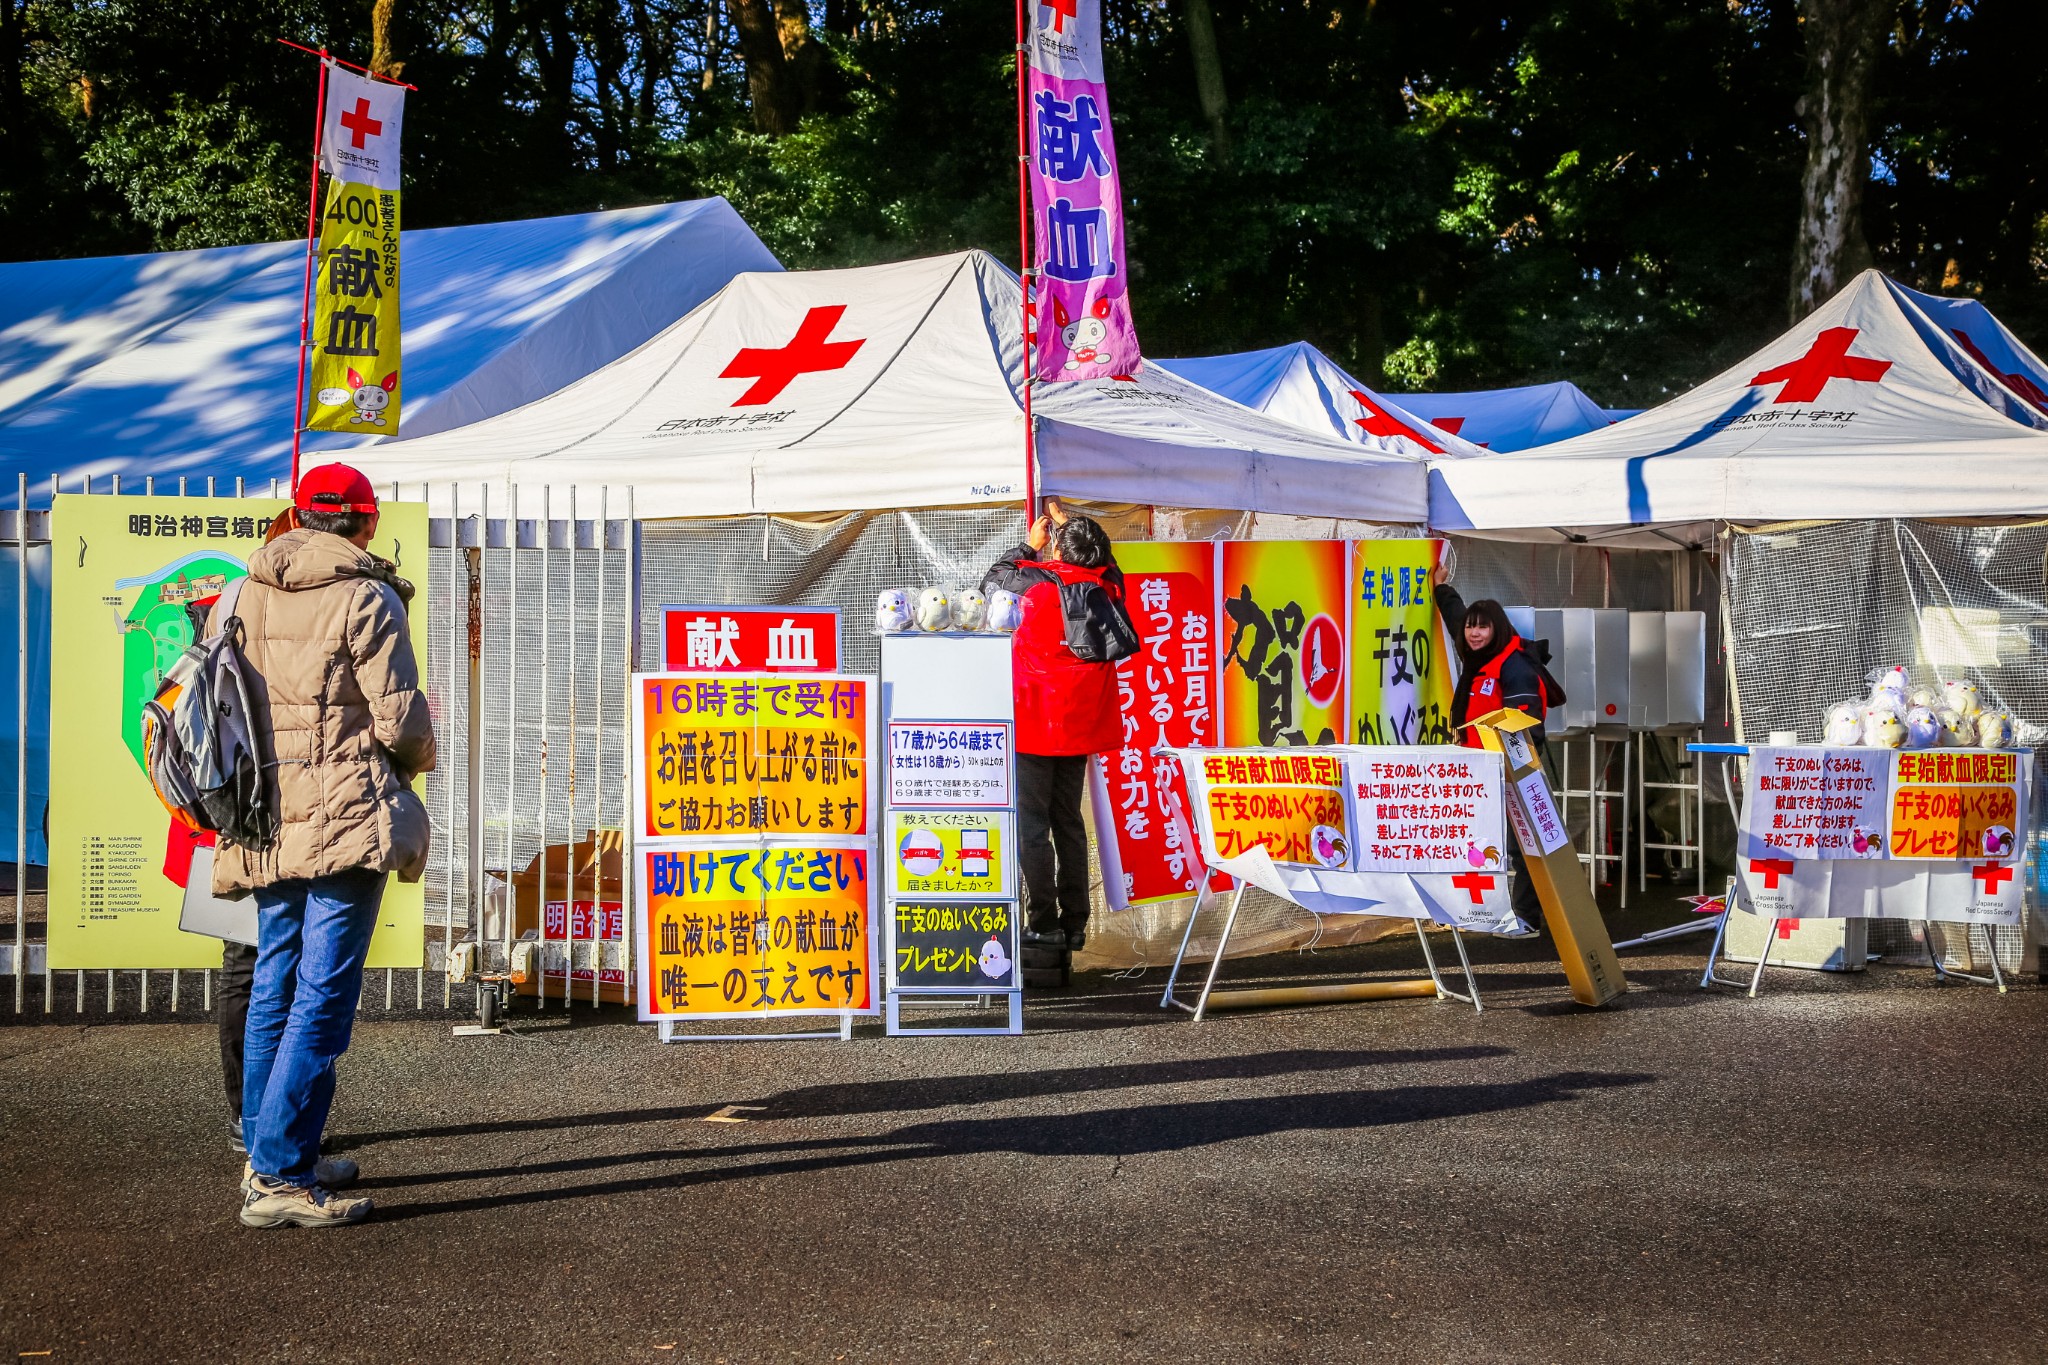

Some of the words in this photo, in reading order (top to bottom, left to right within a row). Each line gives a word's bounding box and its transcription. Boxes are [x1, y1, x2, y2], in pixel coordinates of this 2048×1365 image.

[337, 148, 380, 168] 日本赤十字社
[1034, 89, 1117, 283] 献血
[327, 195, 378, 229] 400
[363, 228, 380, 241] mL
[380, 193, 398, 289] 患者さんのための
[323, 244, 383, 357] 献血
[656, 409, 797, 432] 日本赤十字社
[1705, 425, 1753, 435] Japanese
[1777, 421, 1807, 429] Cross
[1808, 421, 1848, 430] Society
[1712, 408, 1859, 428] 日本赤十字社
[1362, 566, 1432, 609] 年始限定
[685, 617, 818, 668] 献血
[1373, 624, 1430, 689] 干支の
[1181, 610, 1211, 748] お正月で
[650, 680, 860, 719] 16時まで受付
[892, 730, 1005, 751] 17歳から64歳まで
[657, 729, 859, 786] お酒を召し上がる前に
[1775, 756, 1865, 773] 干支のぬいぐるみは、
[1897, 752, 2017, 784] 年始献血限定!!
[1204, 756, 1343, 787] 年始献血限定!!
[1371, 763, 1473, 779] 干支のぬいぐるみは、
[895, 789, 985, 798] 69歳まで可能です。
[1357, 783, 1488, 799] 数に限りがございますので、
[1760, 776, 1876, 792] 数に限りがございますので、
[658, 796, 859, 832] ご協力お願いします
[1212, 791, 1342, 825] 干支のぬいぐるみ
[1376, 803, 1475, 819] 献血できた方のみに
[1775, 795, 1863, 811] 献血できた方のみに
[1896, 790, 2014, 821] 干支のぬいぐるみ
[903, 814, 988, 826] 教えてください
[1377, 824, 1473, 840] 差し上げております。
[1772, 813, 1859, 830] 差し上げております。
[1215, 828, 1311, 861] プレゼント!
[1371, 844, 1467, 860] 予めご了承ください。
[1892, 827, 1981, 856] プレゼント!
[653, 850, 864, 897] 助けてください
[906, 880, 993, 892] 届きましたか？
[1743, 897, 1755, 907] Red
[1755, 900, 1774, 909] Cross
[1774, 902, 1795, 911] Society
[1755, 893, 1785, 902] Japanese
[1976, 899, 2004, 908] Japanese
[896, 905, 1008, 933] 干支のぬいぐるみ
[1965, 906, 1977, 914] Red
[1977, 907, 1994, 915] Cross
[1994, 908, 2013, 917] Society
[659, 909, 859, 958] 血液は皆様の献血が
[896, 945, 978, 973] プレゼント
[661, 960, 861, 1010] 唯一の支えです
